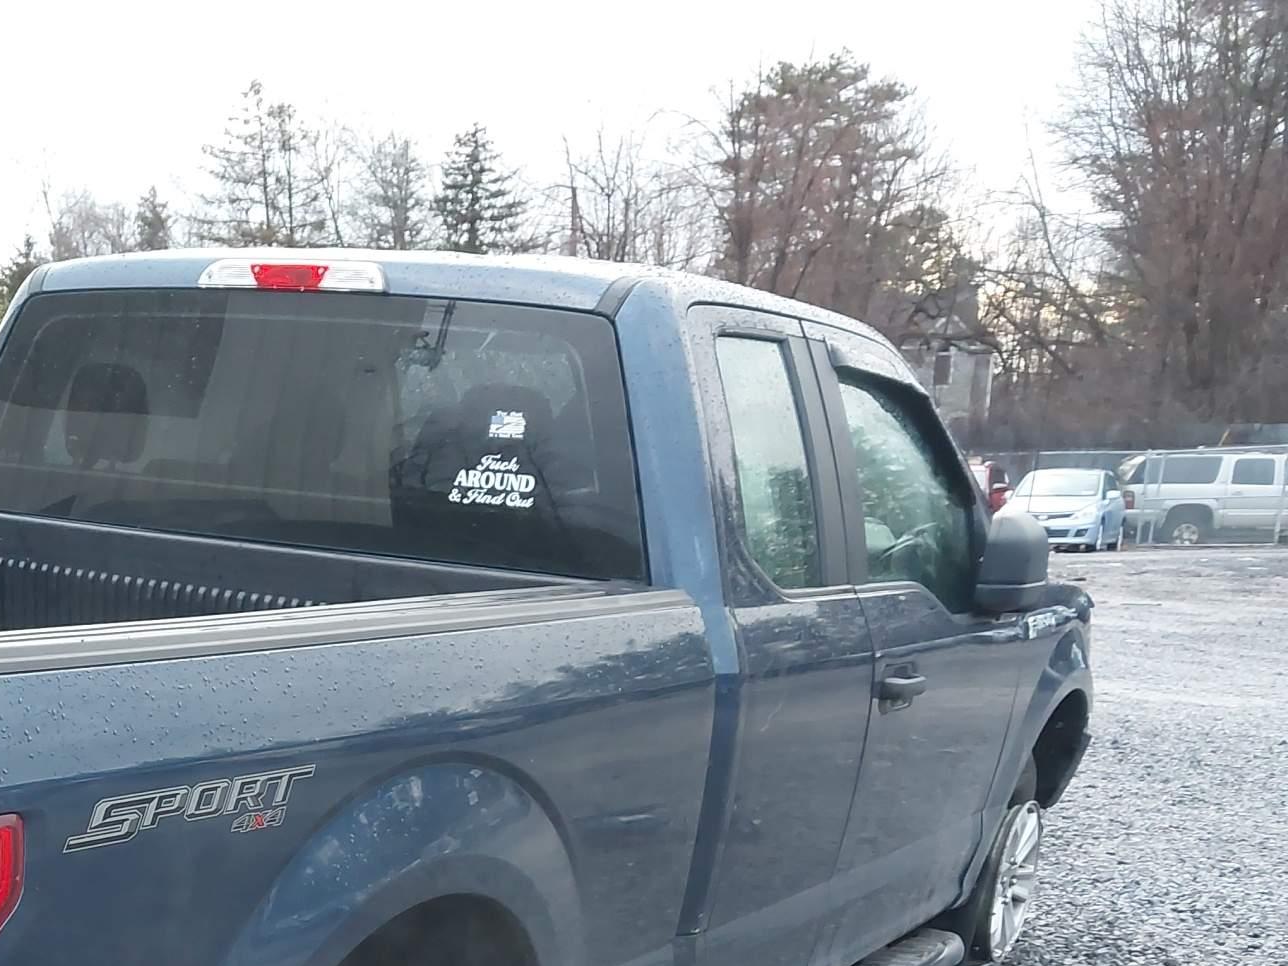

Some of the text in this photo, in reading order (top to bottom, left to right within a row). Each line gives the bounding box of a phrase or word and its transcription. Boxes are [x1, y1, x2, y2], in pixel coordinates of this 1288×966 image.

[476, 453, 520, 472] Fuck
[453, 468, 536, 493] AROUND
[448, 488, 535, 509] & Find Out
[62, 764, 316, 853] SPORT
